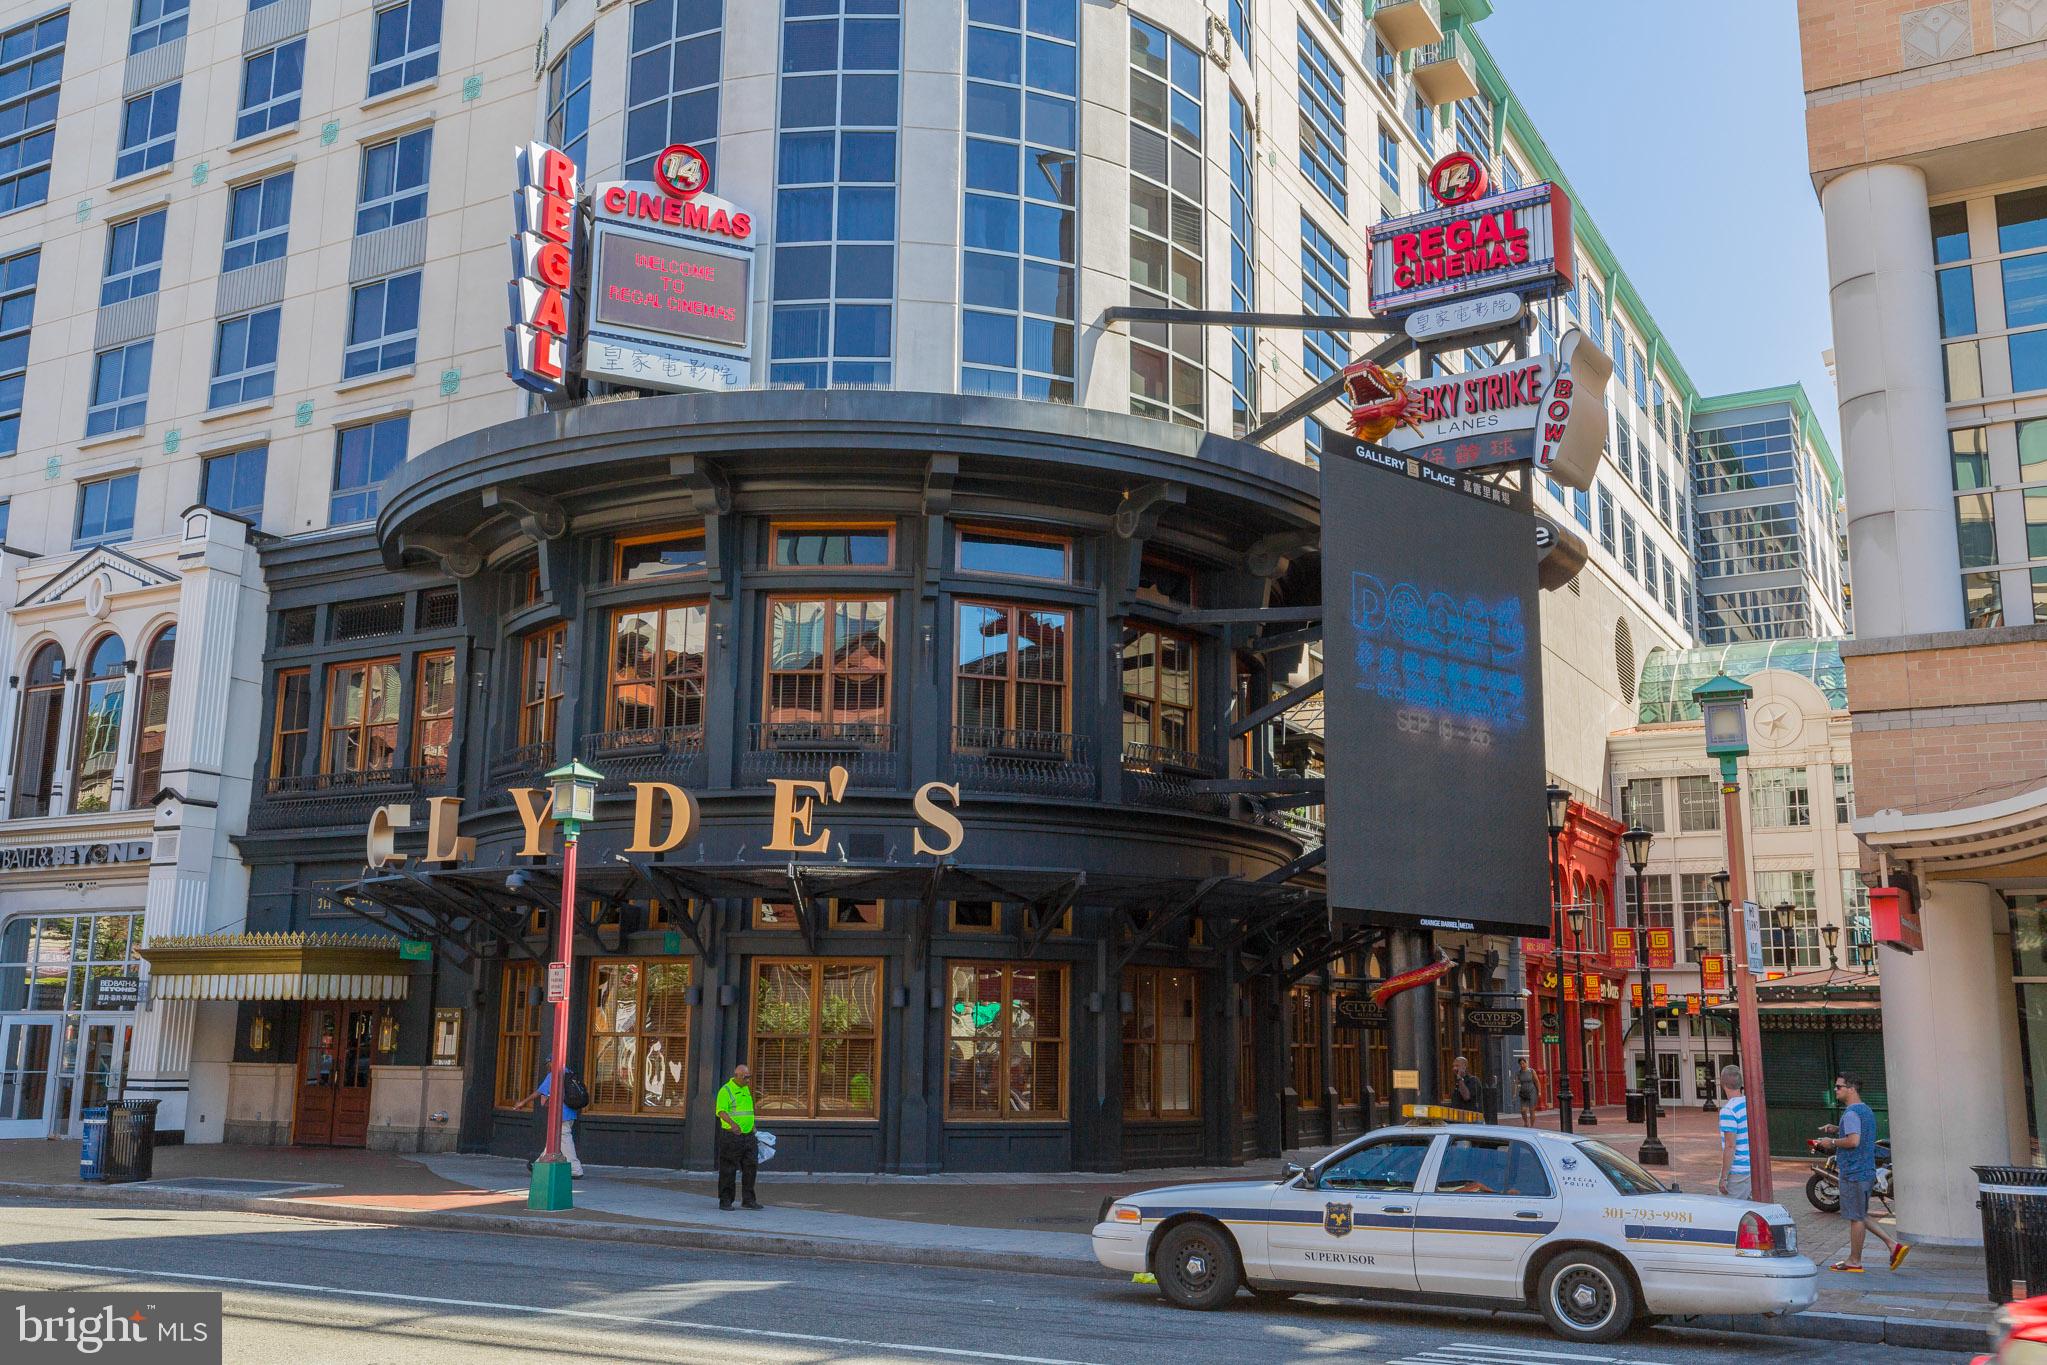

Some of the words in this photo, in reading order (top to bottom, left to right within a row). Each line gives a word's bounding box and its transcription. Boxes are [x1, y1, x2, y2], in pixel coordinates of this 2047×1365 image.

[667, 154, 702, 183] 14
[1440, 163, 1470, 192] 14
[604, 187, 752, 240] CINEMAS
[1392, 209, 1529, 266] REGAL
[534, 150, 575, 379] REGAL
[634, 252, 715, 281] WELCOME
[1394, 239, 1529, 289] CINEMAS
[608, 285, 662, 309] REGAL
[667, 296, 736, 321] CINEMAS
[660, 276, 685, 295] TO
[1416, 298, 1512, 334] 皇家電影院
[599, 345, 738, 385] 皇家電影院
[1464, 364, 1543, 414] STRIKE
[1437, 414, 1499, 435] LANES
[1540, 379, 1574, 465] BOWL
[1356, 445, 1405, 471] GALLERY
[1423, 466, 1456, 487] PLACE
[367, 766, 965, 870] CLYDE'S
[2, 848, 38, 869] BATH
[39, 846, 50, 867] &
[53, 841, 153, 865] BEYOND
[100, 979, 113, 988] BED
[113, 979, 131, 988] BATH
[1474, 1013, 1517, 1021] CLYDE'S
[1602, 1207, 1694, 1223] 301-793-9981
[1304, 1251, 1376, 1266] SUPERVISOR
